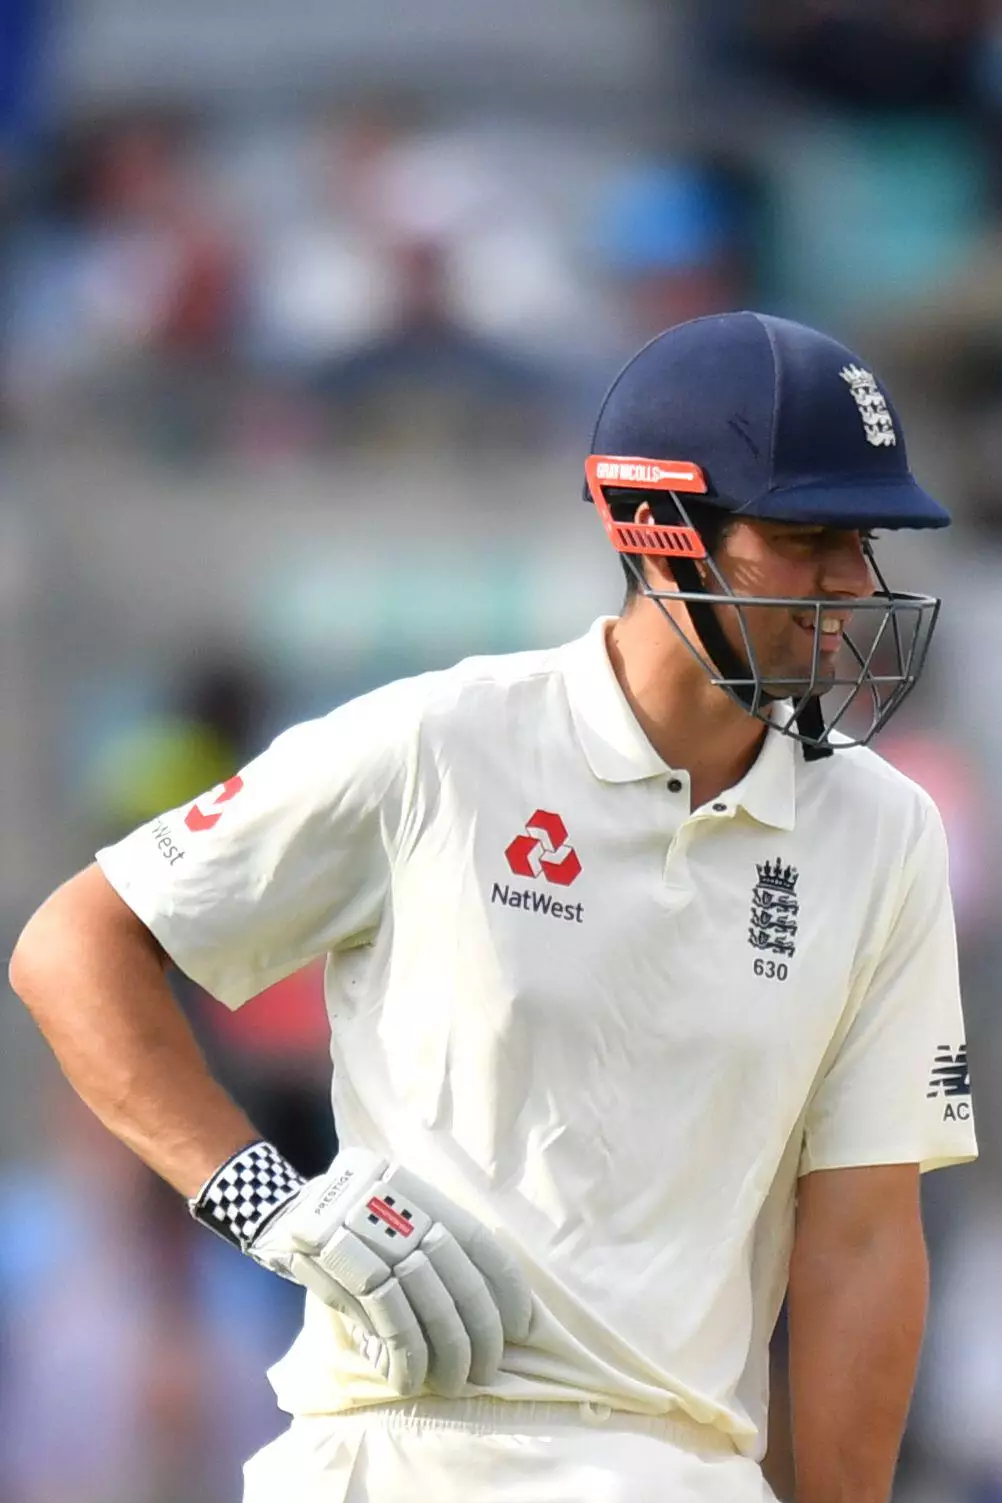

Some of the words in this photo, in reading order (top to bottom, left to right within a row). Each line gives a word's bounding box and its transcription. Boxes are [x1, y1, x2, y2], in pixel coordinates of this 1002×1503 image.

[152, 818, 185, 866] West
[491, 882, 585, 924] NatWest
[753, 957, 789, 982] 630
[943, 1102, 971, 1121] AC
[314, 1169, 354, 1215] PRESTIGE
